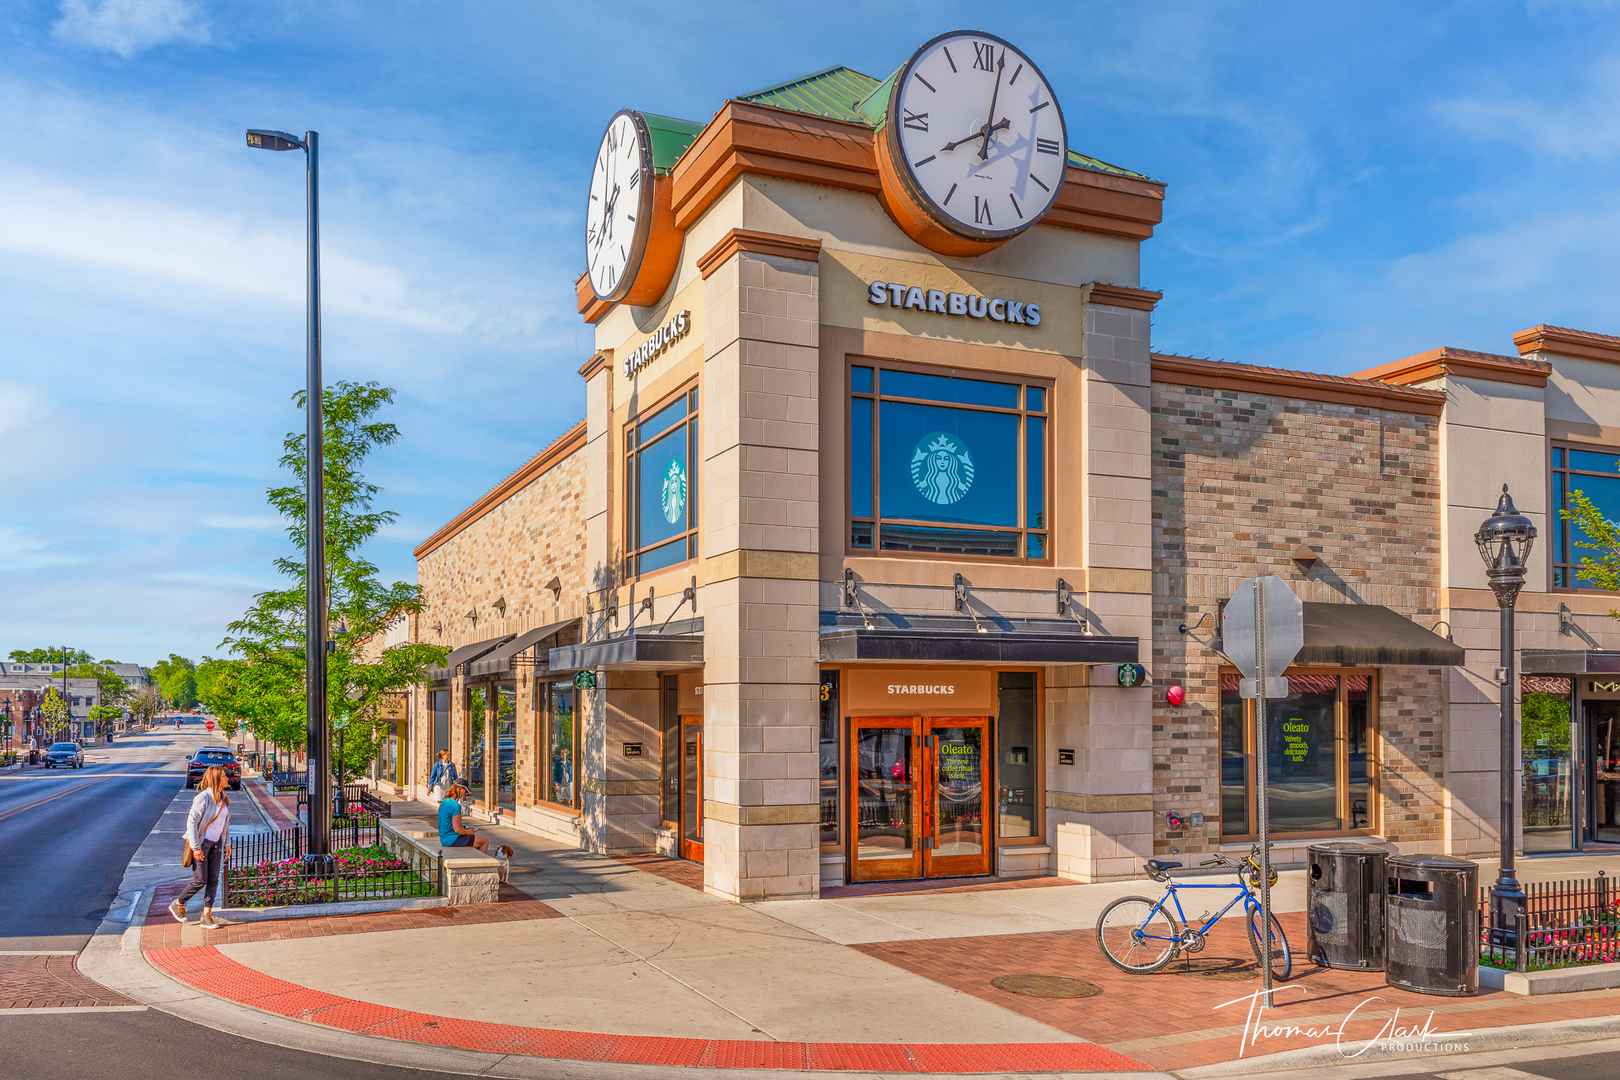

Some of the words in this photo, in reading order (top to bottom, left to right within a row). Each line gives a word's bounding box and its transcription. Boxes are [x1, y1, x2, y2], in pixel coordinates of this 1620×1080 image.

[868, 280, 1041, 327] STARBUCKS
[623, 309, 687, 378] STARBUCKS
[887, 684, 955, 695] STARBUCKS
[1283, 722, 1310, 733] Oleato
[941, 743, 974, 755] Oleato
[942, 764, 958, 772] coffee
